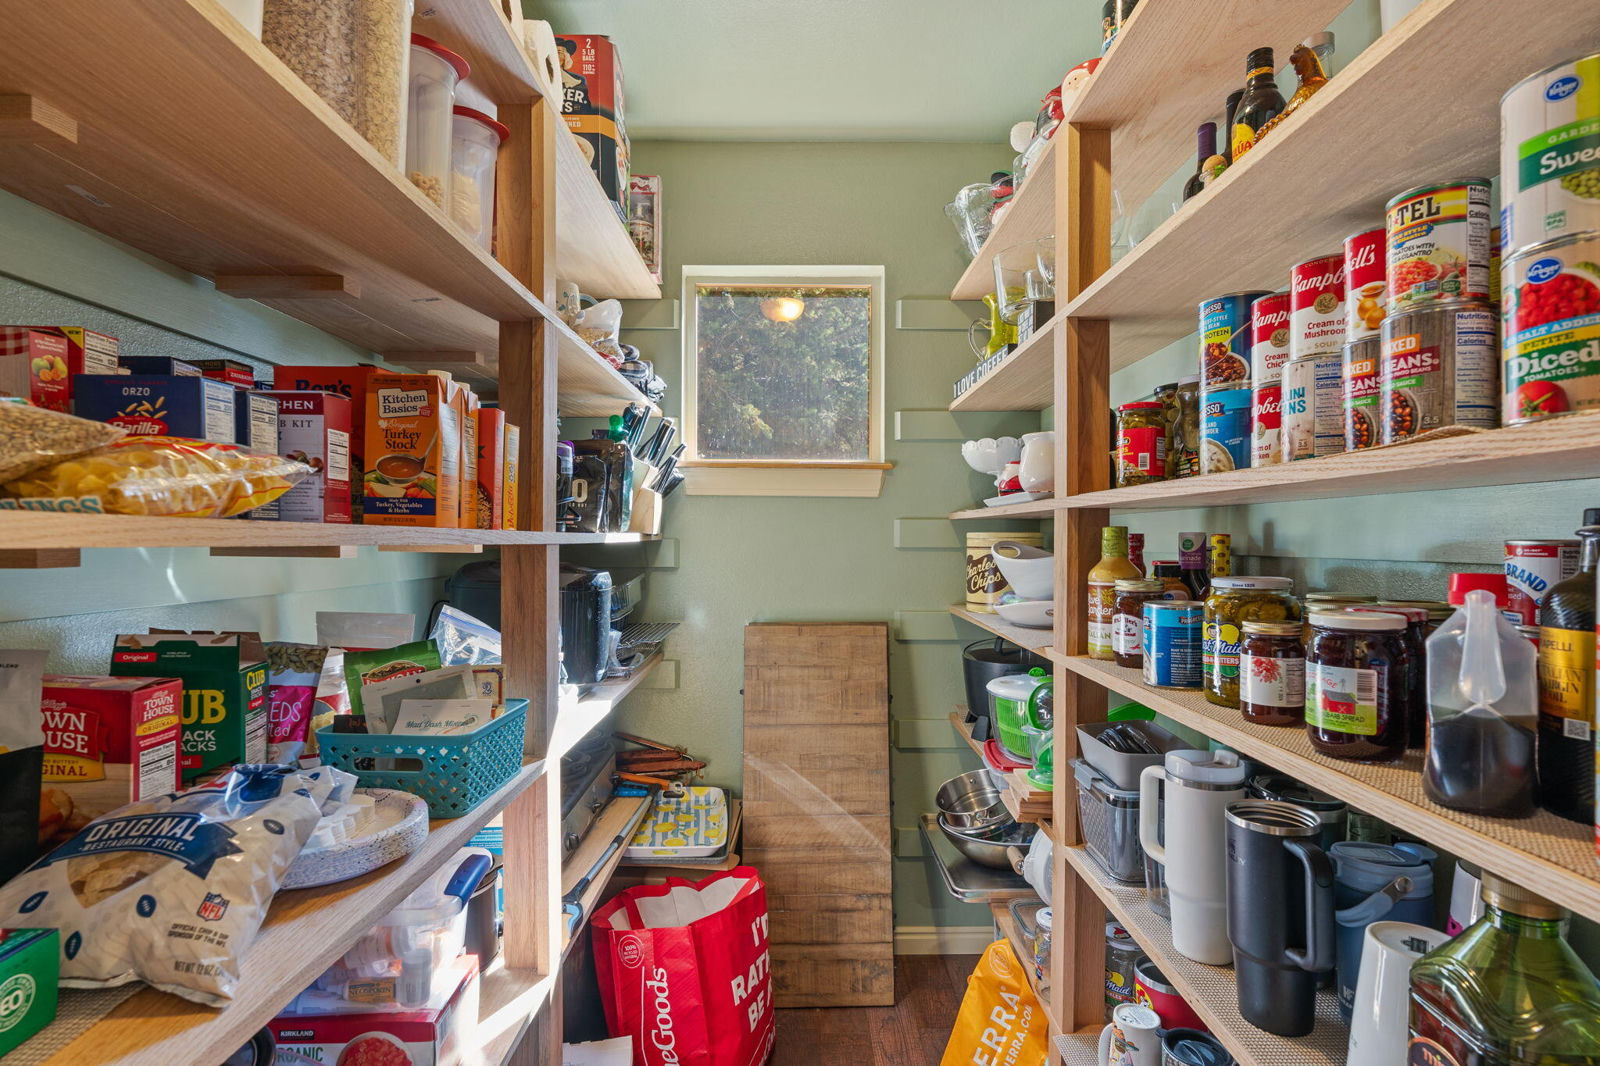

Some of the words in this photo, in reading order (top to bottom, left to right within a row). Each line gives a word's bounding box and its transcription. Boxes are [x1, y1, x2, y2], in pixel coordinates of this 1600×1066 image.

[586, 38, 591, 48] 2
[1527, 263, 1561, 279] Kroger
[1308, 319, 1335, 330] Cream
[1517, 326, 1549, 341] SALT
[1523, 332, 1575, 350] PETITE
[1388, 336, 1416, 353] XED
[1264, 353, 1288, 362] Cream
[1509, 339, 1600, 379] Diced
[957, 371, 976, 397] LOVE
[976, 348, 1008, 381] COFFEE
[1523, 365, 1579, 383] TOMATOES
[122, 387, 150, 396] ORZO
[382, 393, 426, 404] Kitchen
[383, 404, 418, 414] Basics
[1423, 415, 1439, 424] 3.5
[383, 427, 421, 440] Turkey
[385, 438, 417, 449] Stock
[971, 570, 1001, 591] Chips
[1506, 562, 1547, 592] BRAND
[246, 669, 266, 690] CLUB
[144, 694, 174, 710] TOWN
[143, 704, 175, 721] HOUSE
[183, 730, 216, 741] ACK
[85, 817, 199, 842] ORIGINAL
[82, 837, 152, 851] RESTAURANT
[152, 838, 184, 851] STYLE
[200, 901, 222, 919] NFL
[167, 930, 194, 939] SPONSOR
[171, 923, 198, 932] OFFICIAL
[748, 990, 765, 1033] BE
